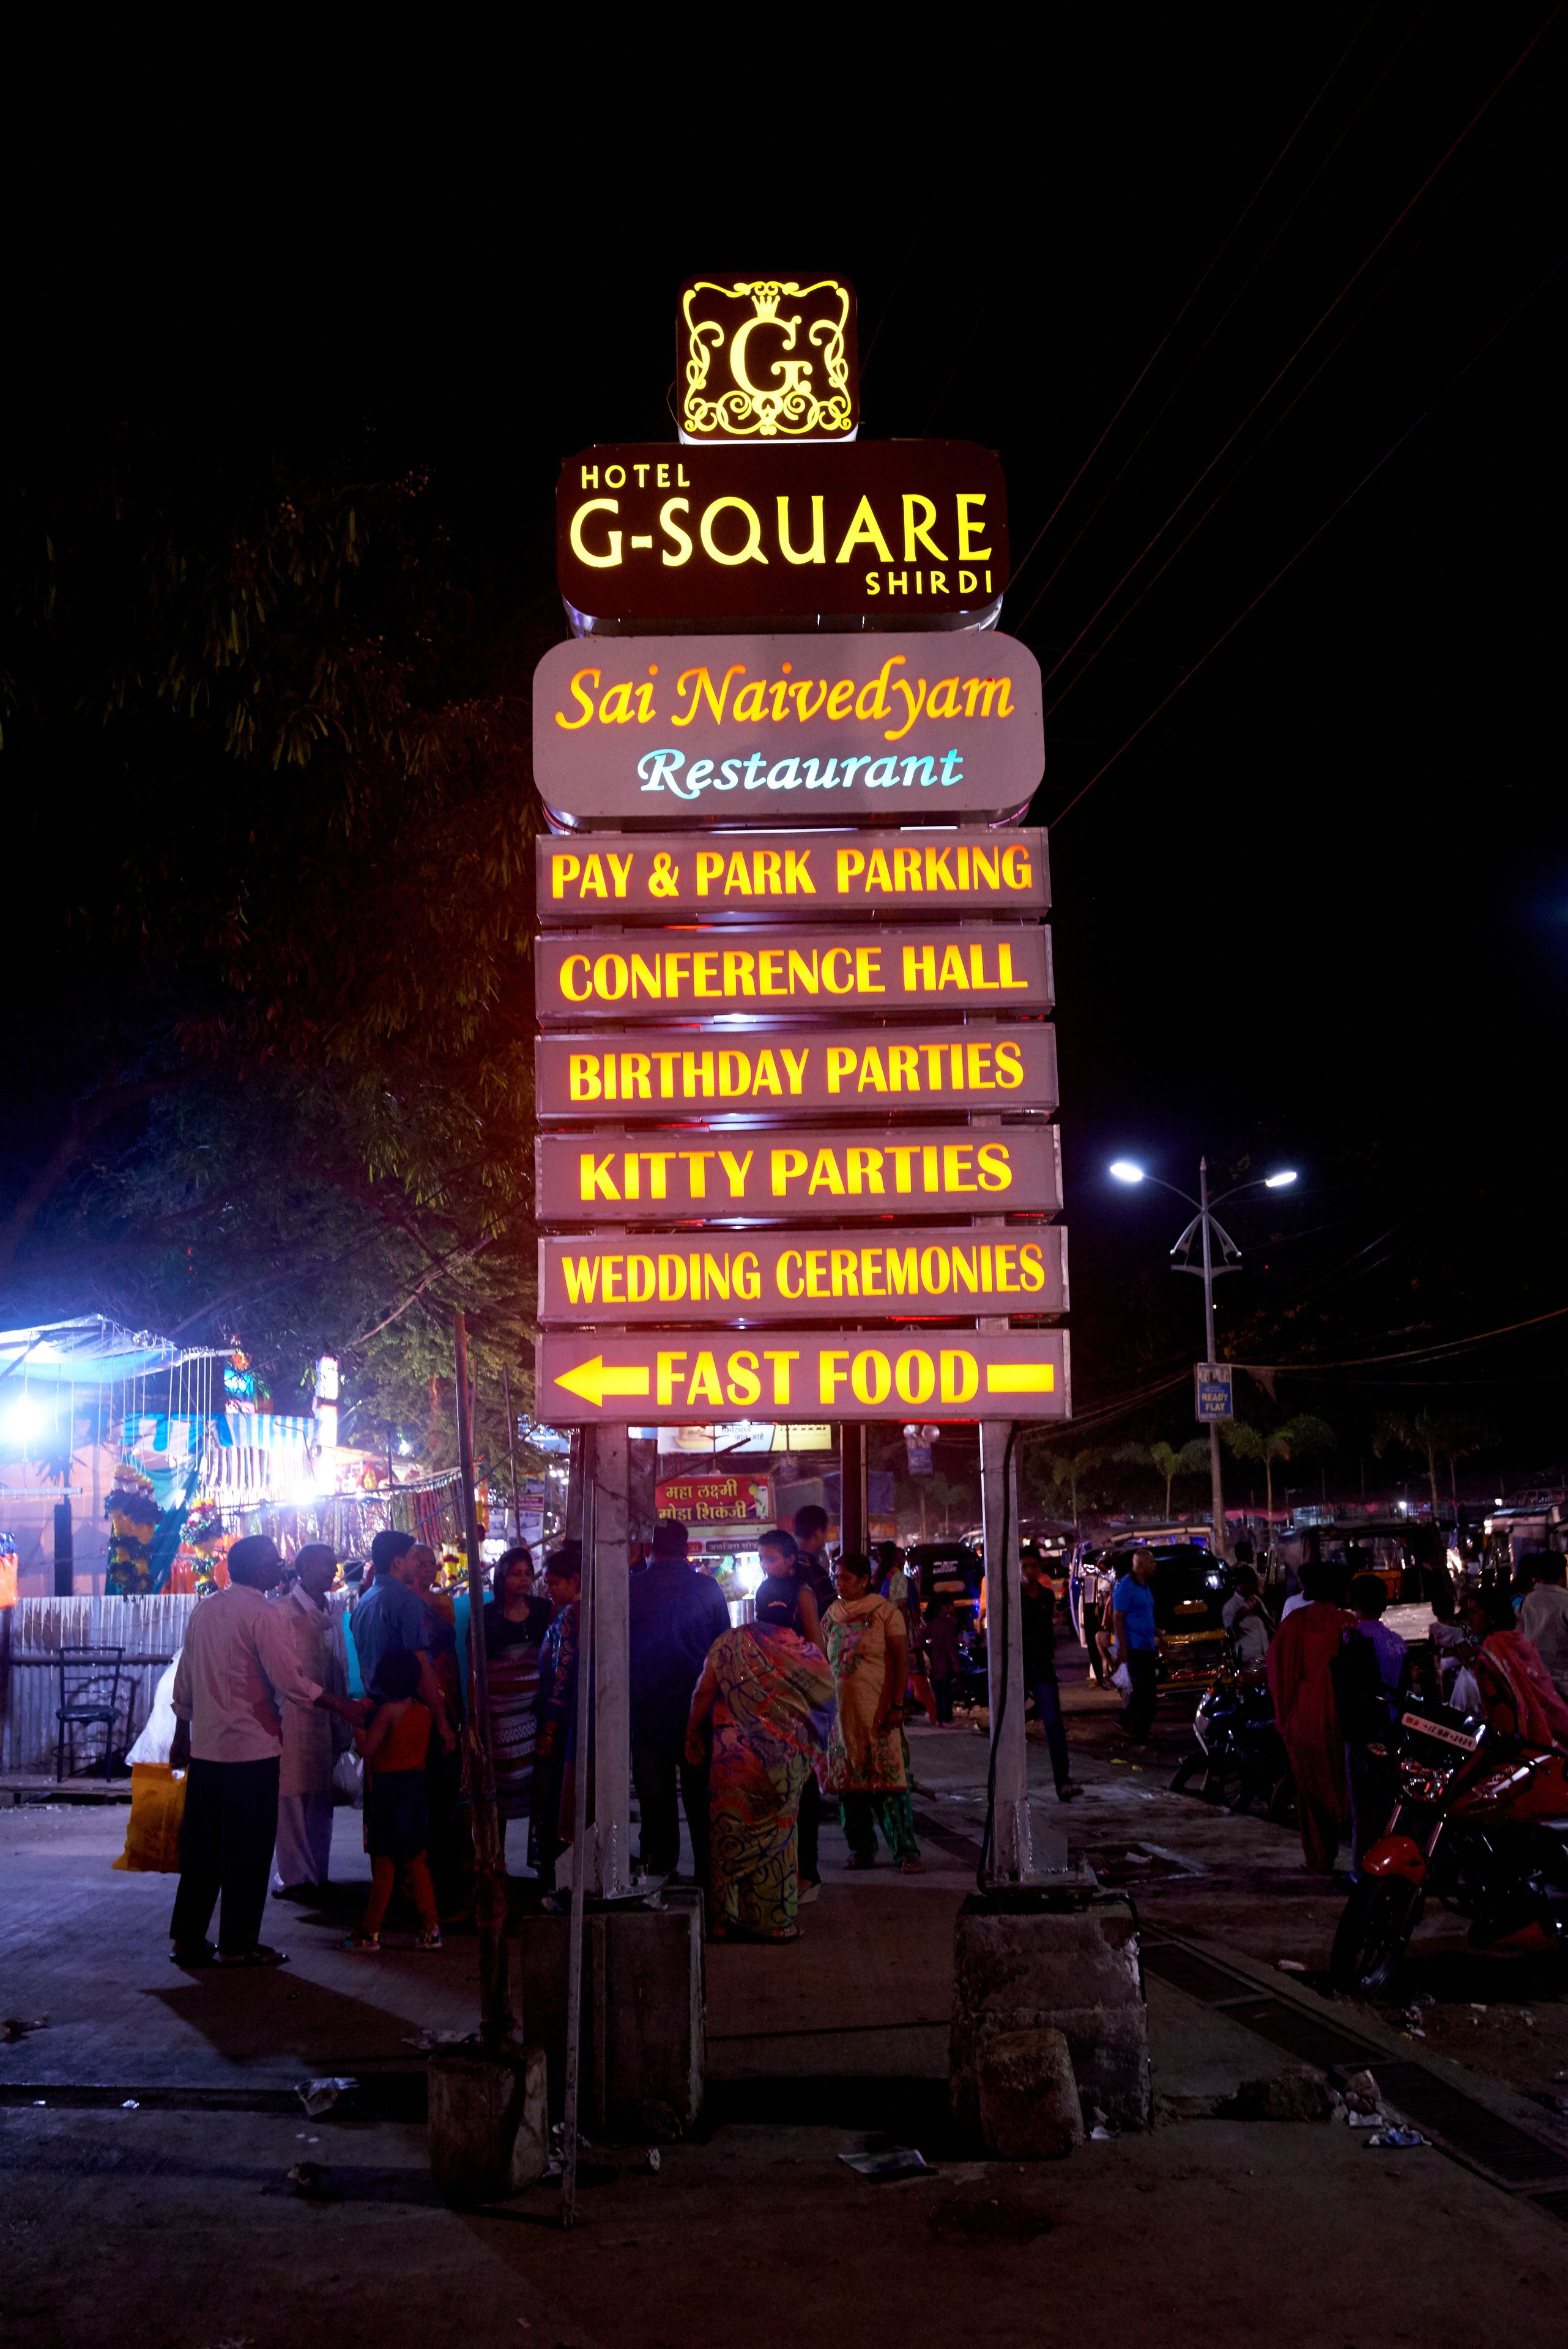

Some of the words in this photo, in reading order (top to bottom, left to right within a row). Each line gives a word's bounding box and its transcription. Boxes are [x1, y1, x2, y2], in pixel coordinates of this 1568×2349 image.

[582, 464, 689, 489] HOTEL
[570, 494, 991, 568] G-SQUARE
[866, 571, 991, 595] SHIRDI
[555, 664, 658, 730] Sai
[671, 655, 1014, 741] Naivedyam
[637, 749, 963, 799] Restaurant
[552, 853, 633, 898] PAY
[648, 852, 679, 897] &
[696, 850, 816, 896] PARK
[837, 847, 1031, 893] PARKING
[560, 948, 885, 1001] CONFERENCE
[903, 944, 1028, 991] HALL
[570, 1048, 809, 1100] BIRTHDAY
[827, 1042, 1024, 1093] PARTIES
[581, 1150, 753, 1200] KITTY
[771, 1143, 1012, 1196] PARTIES
[562, 1252, 760, 1304] WEDDING
[776, 1244, 1045, 1299] CEREMONIES
[657, 1350, 800, 1406] FAST
[819, 1349, 979, 1405] FOOD
[1202, 1393, 1228, 1401] READY
[1205, 1403, 1225, 1411] FLAT
[666, 1485, 693, 1500] महा
[697, 1478, 738, 1500] लक्ष्मी
[695, 1500, 747, 1521] शिकंजी
